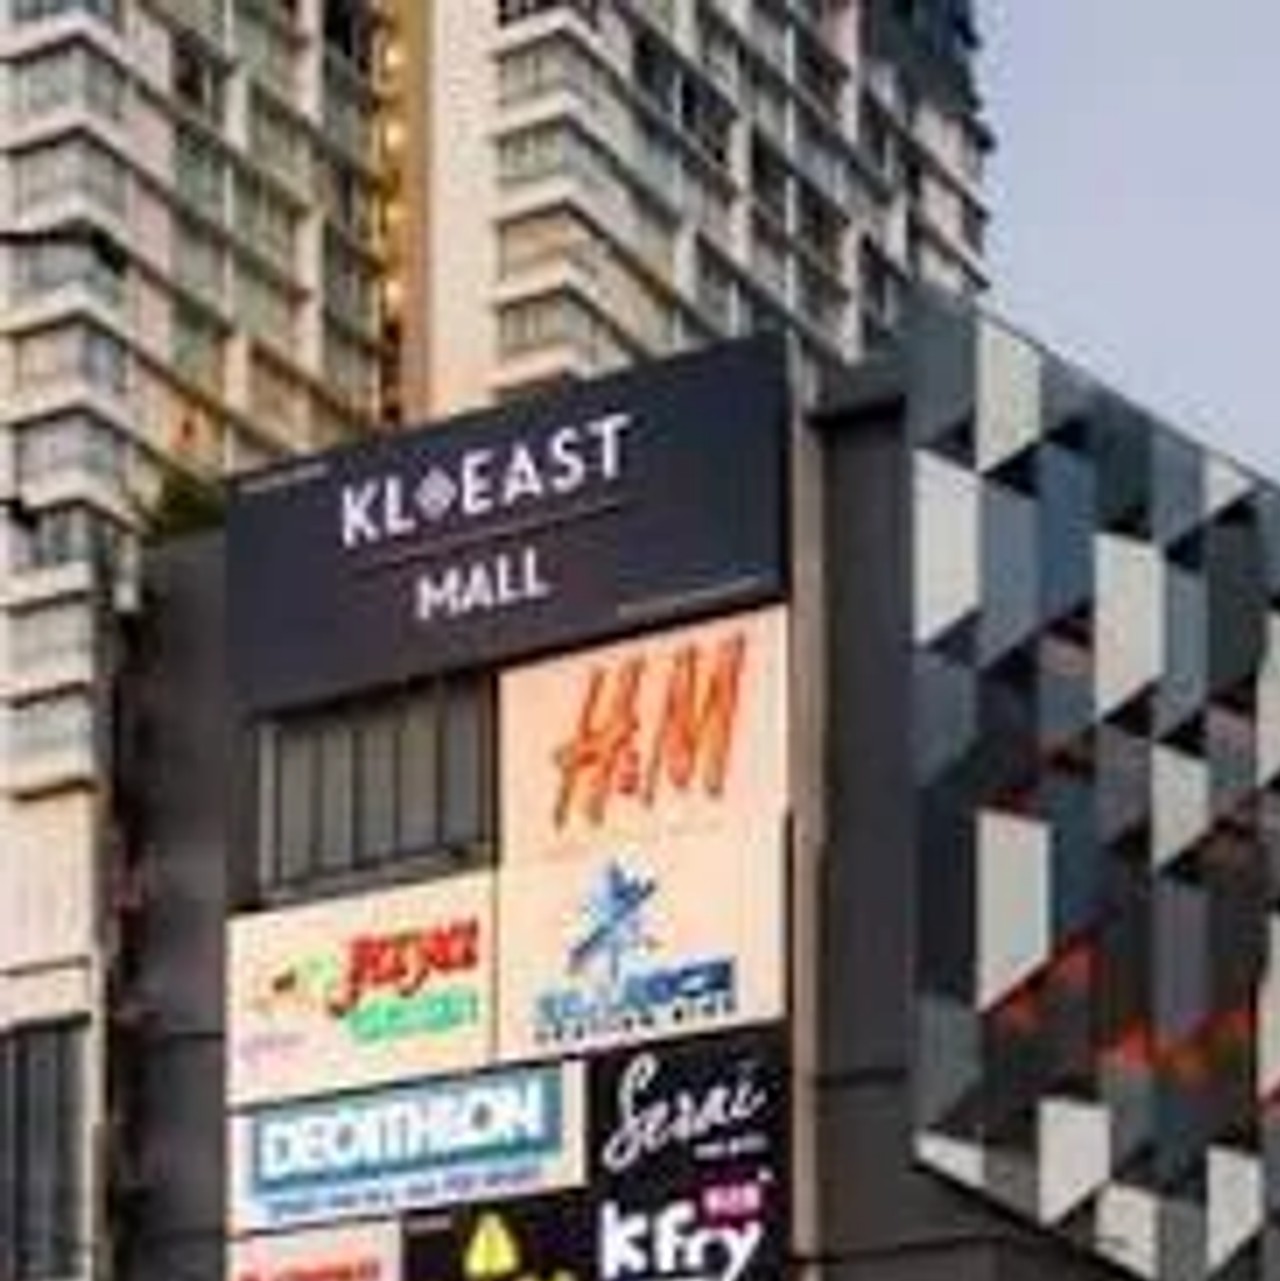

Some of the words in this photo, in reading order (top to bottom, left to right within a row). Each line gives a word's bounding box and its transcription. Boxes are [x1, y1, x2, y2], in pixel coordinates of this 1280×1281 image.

[341, 479, 418, 548] KL
[461, 412, 632, 516] EAST
[417, 547, 550, 620] MALL
[553, 632, 747, 831] H&M
